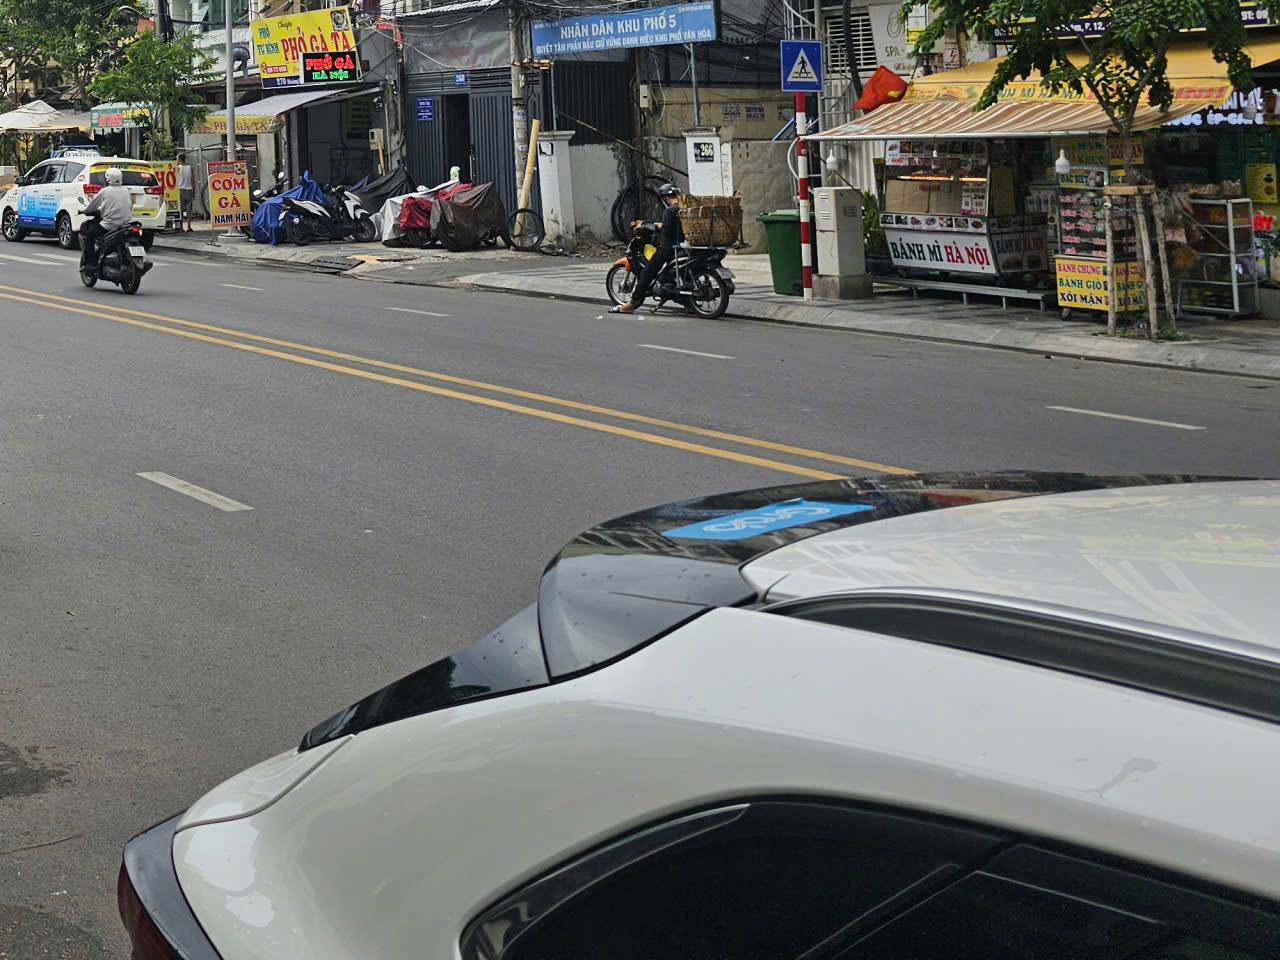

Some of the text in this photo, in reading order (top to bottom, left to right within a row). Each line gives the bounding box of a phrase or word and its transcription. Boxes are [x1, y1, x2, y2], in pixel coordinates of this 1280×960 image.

[560, 21, 589, 39] NHÂN
[591, 19, 614, 36] DÂN
[617, 18, 640, 33] KHU
[643, 10, 667, 31] PHỐ
[669, 14, 677, 28] 5
[281, 25, 351, 61] PHỞ GÀ TA
[535, 40, 553, 54] QUYẾT
[554, 41, 566, 52] TÂM
[566, 39, 581, 51] PHẤN
[582, 36, 594, 49] ĐẤU
[622, 36, 639, 46] DANH
[639, 33, 654, 44] HIỆU
[655, 33, 668, 42] KHU
[669, 27, 682, 41] PHỐ
[683, 29, 696, 40] VĂN
[697, 25, 712, 39] HÓA
[884, 46, 900, 57] SPA
[305, 53, 332, 71] PHỞ
[236, 119, 250, 131] GÀ
[700, 143, 714, 157] 266
[155, 162, 177, 191] HỞ
[211, 176, 246, 191] CƠM
[217, 192, 241, 208] GÀ
[214, 213, 233, 224] NAM
[890, 237, 991, 271] BÁNH MÌ HÀ NỘI
[1058, 275, 1102, 290] BÁNH GIÒ
[1059, 290, 1103, 307] XÔI MẶN
